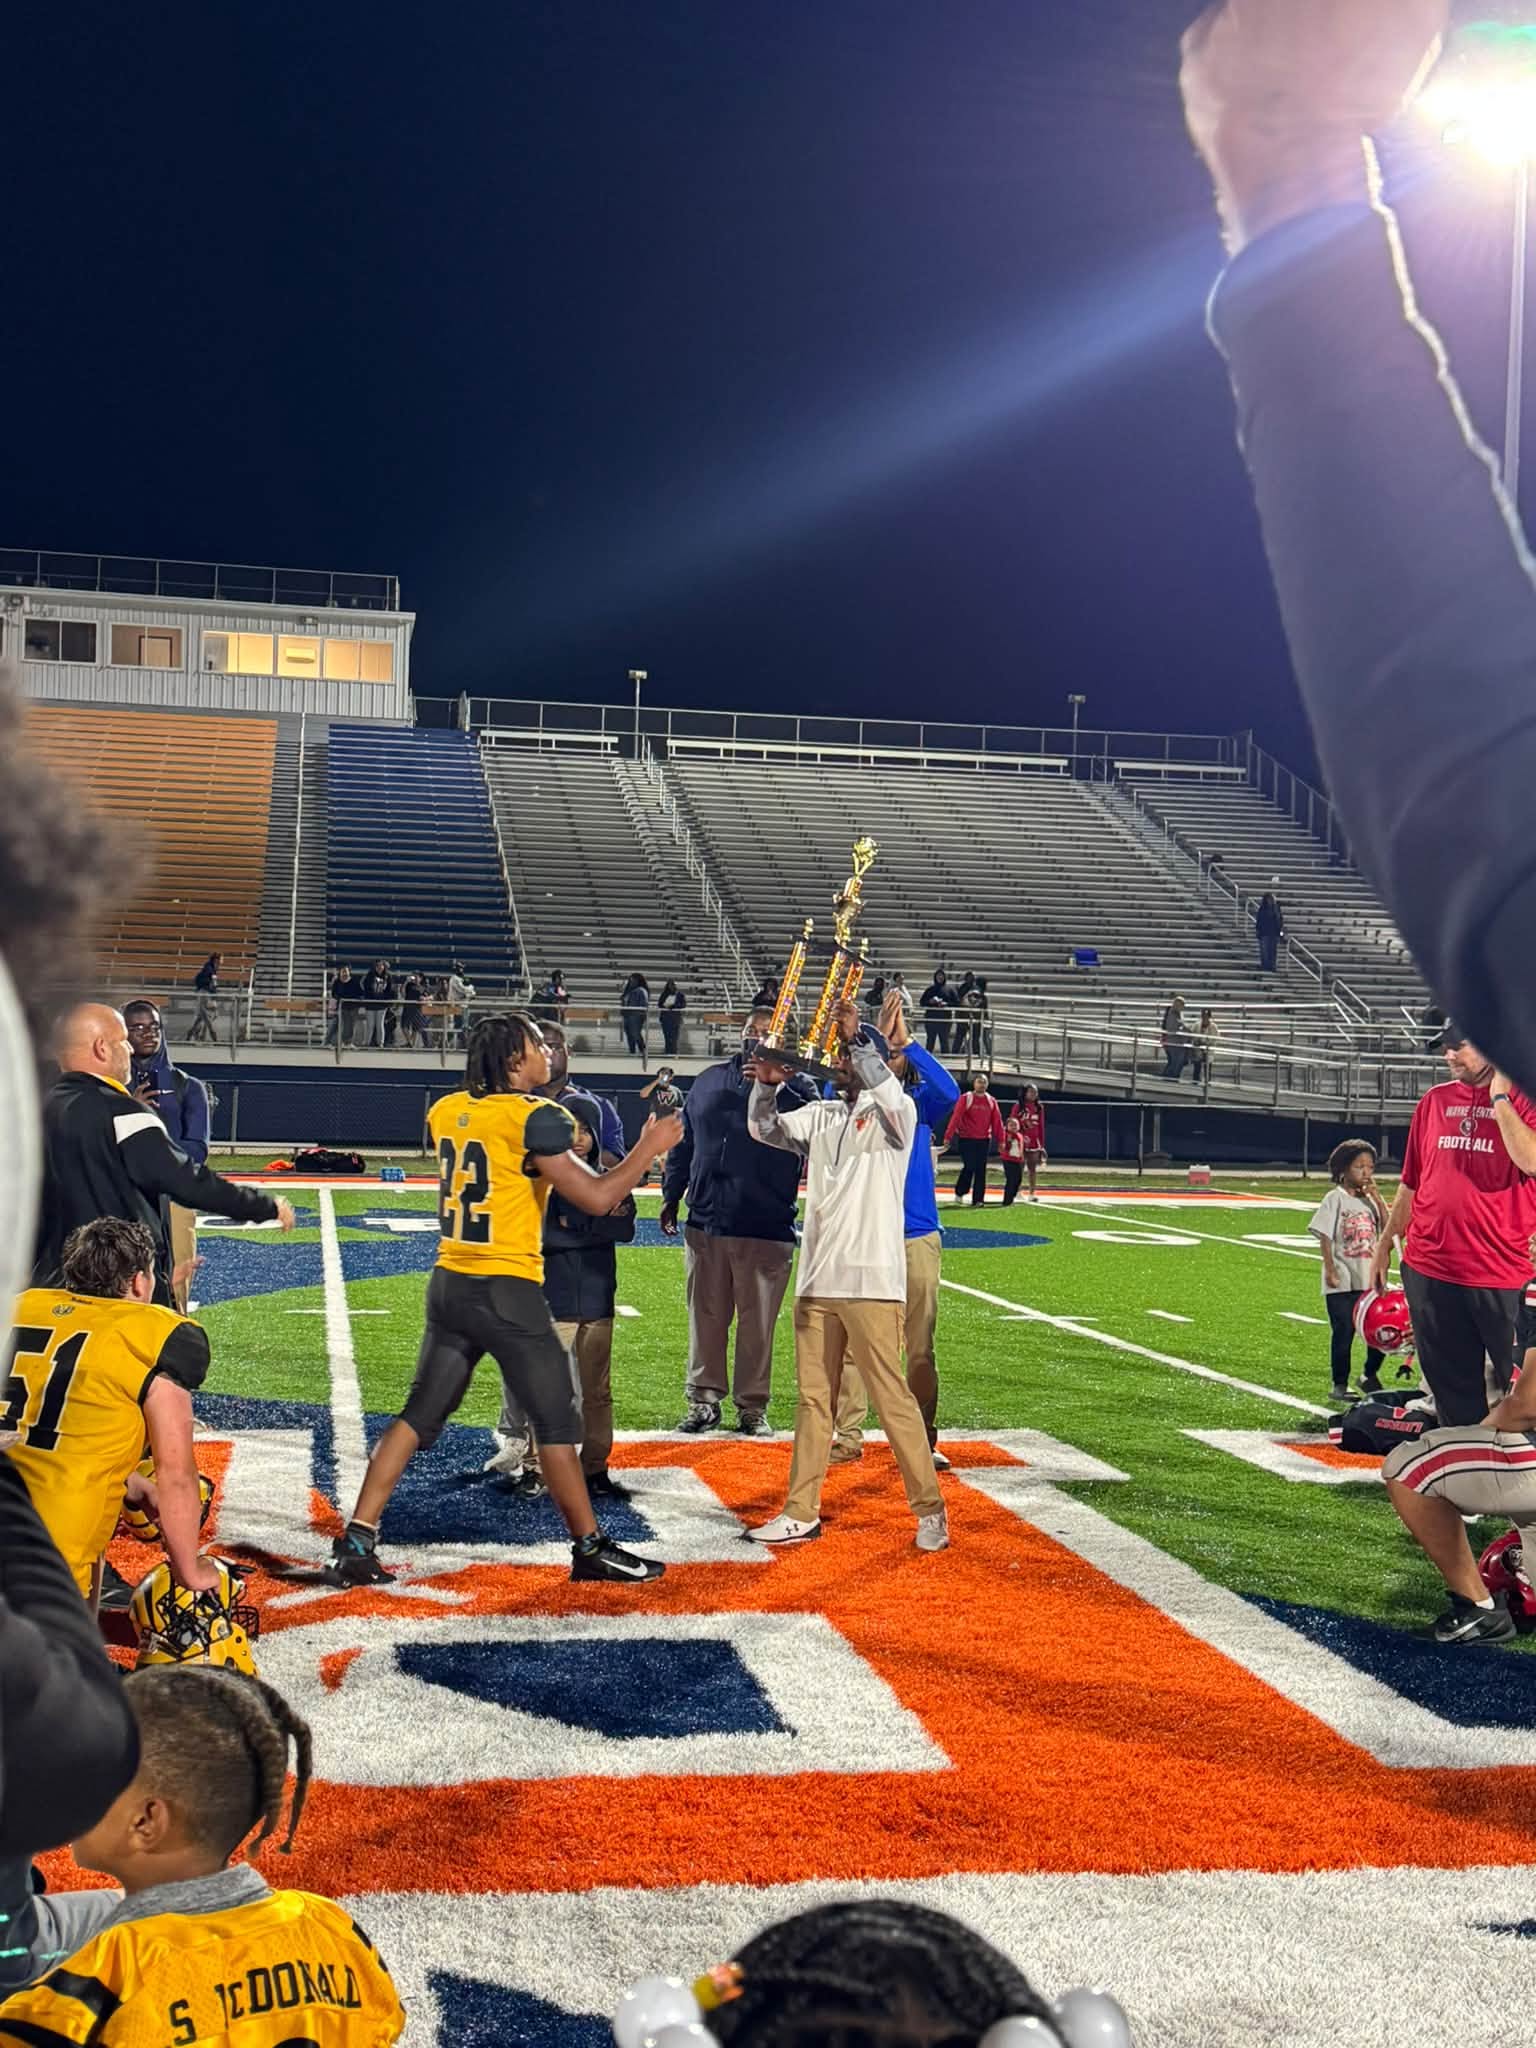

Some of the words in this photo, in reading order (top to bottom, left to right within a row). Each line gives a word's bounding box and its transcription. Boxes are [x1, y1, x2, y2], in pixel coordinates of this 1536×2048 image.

[1438, 1135, 1495, 1154] FOOTBALL
[439, 1136, 494, 1246] 22
[0, 1324, 93, 1452] 51
[168, 1998, 197, 2047] S
